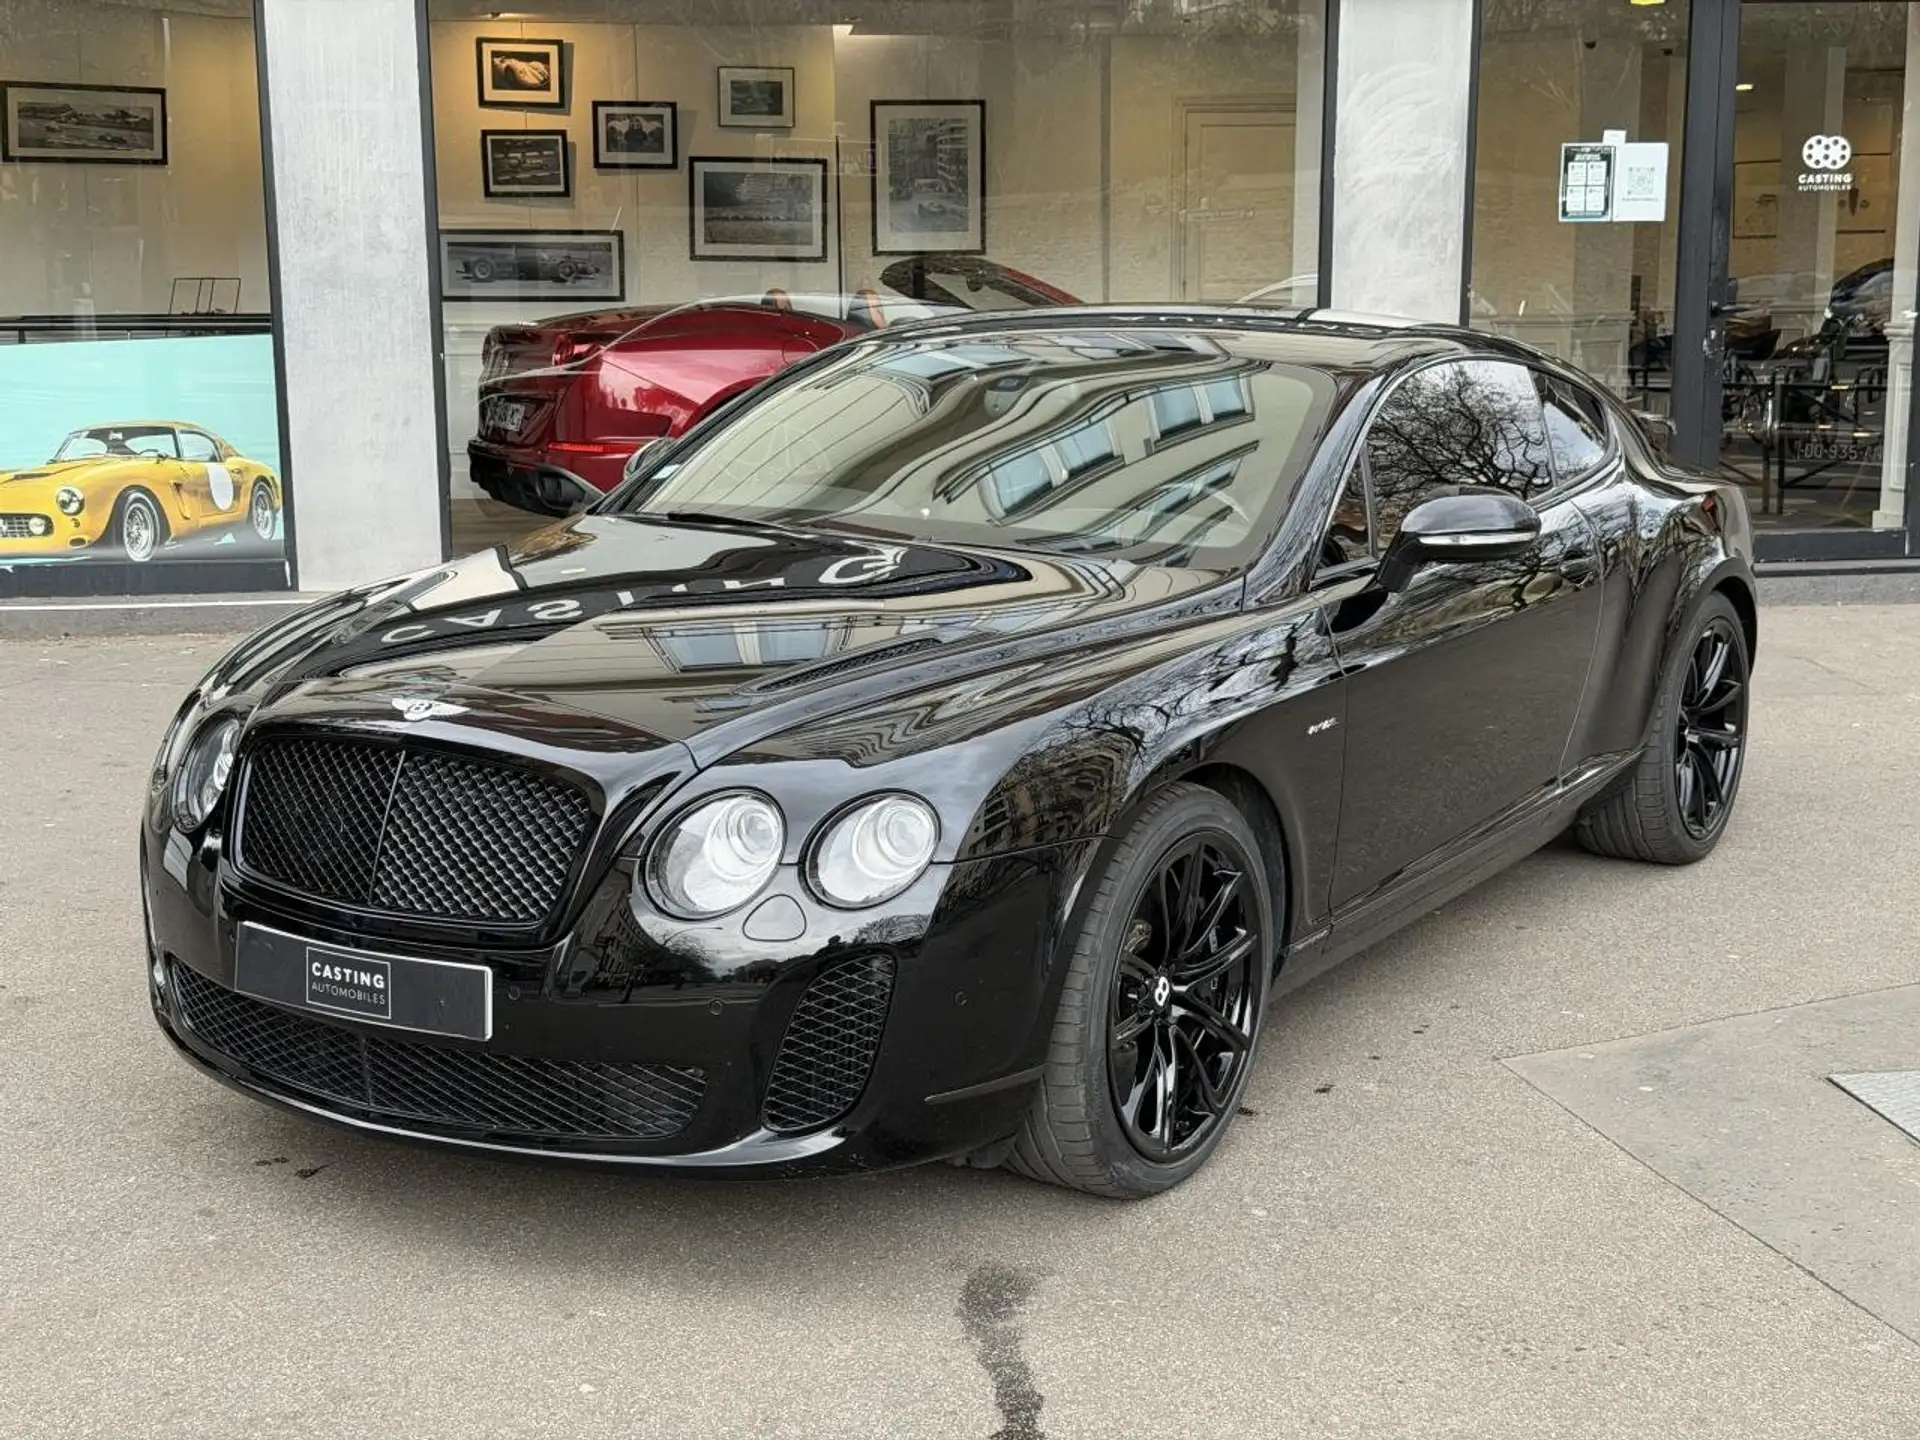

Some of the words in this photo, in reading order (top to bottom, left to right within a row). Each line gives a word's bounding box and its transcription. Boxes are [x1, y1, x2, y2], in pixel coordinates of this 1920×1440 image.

[1798, 173, 1852, 184] CASTING
[1798, 184, 1852, 192] AUTOMOBILES
[311, 961, 385, 990] CASTING
[311, 981, 386, 1005] AUTOMOBILES
